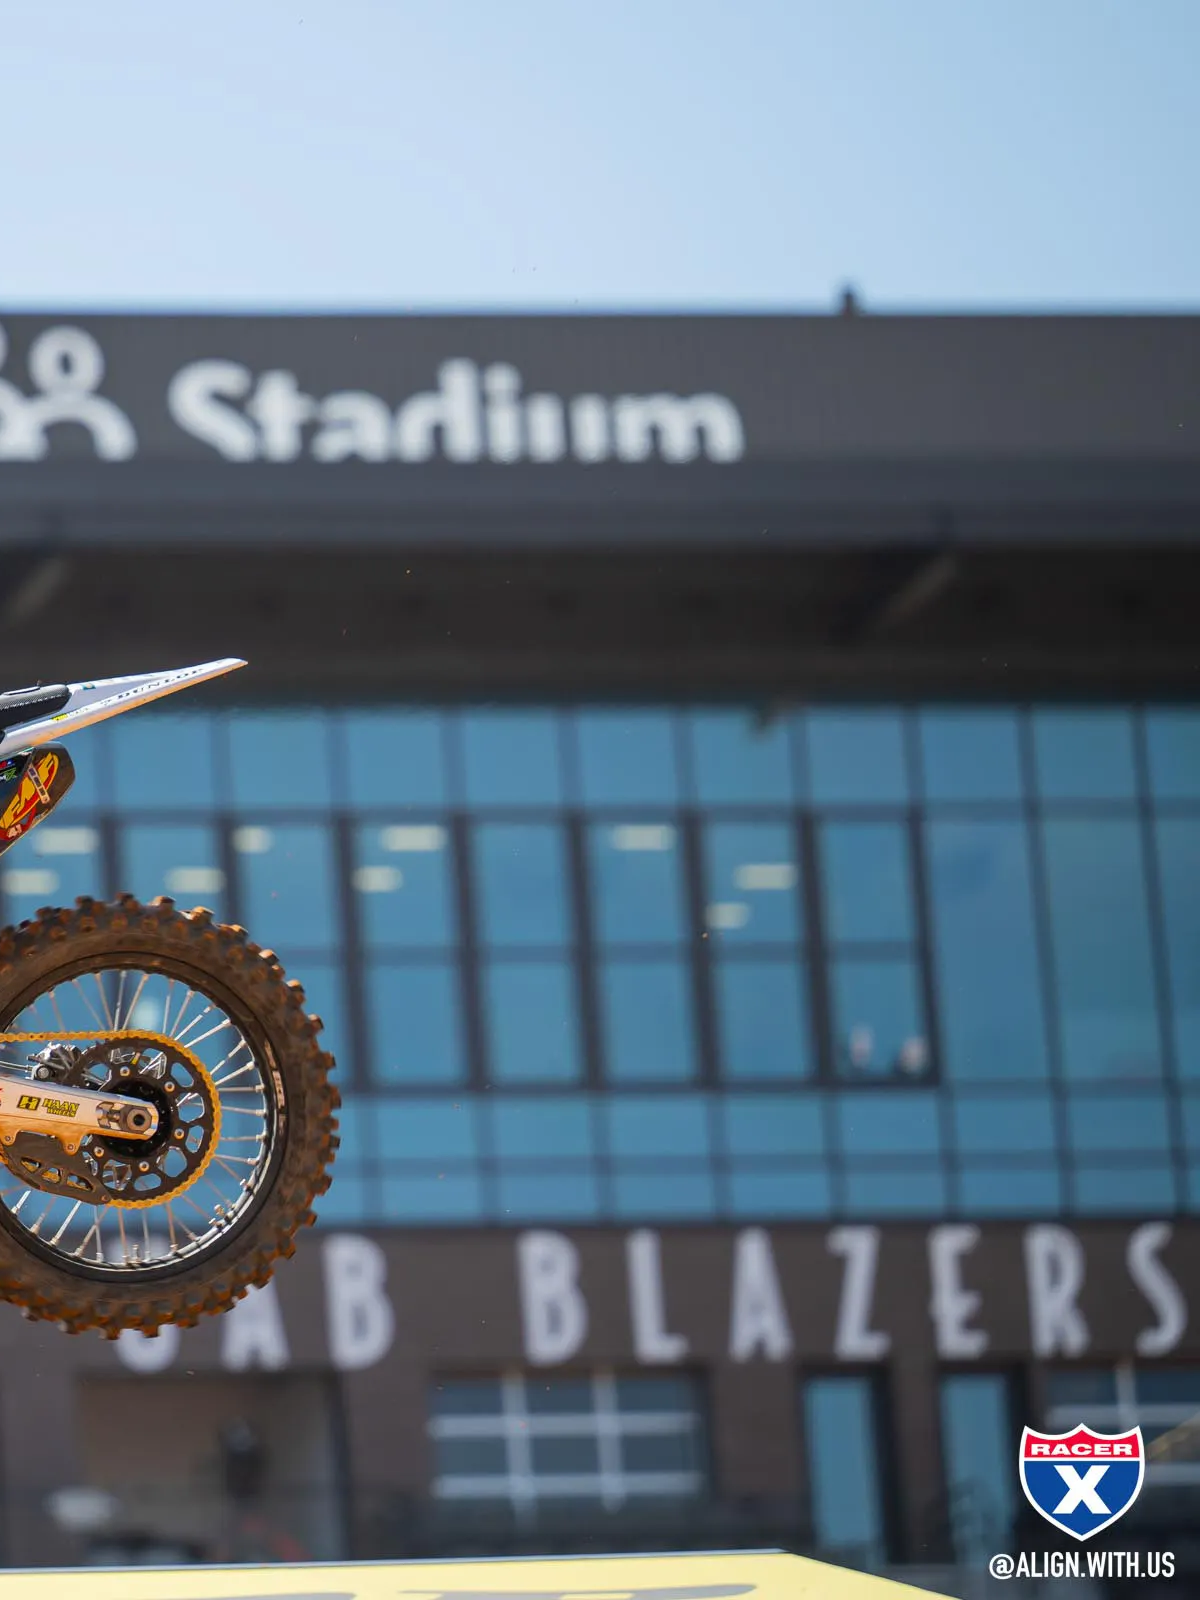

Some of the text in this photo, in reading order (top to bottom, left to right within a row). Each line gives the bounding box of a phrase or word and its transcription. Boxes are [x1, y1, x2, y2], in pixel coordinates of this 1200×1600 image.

[167, 355, 745, 464] Stadium
[41, 1098, 81, 1111] HAAN
[514, 1220, 1189, 1369] BLAZERS
